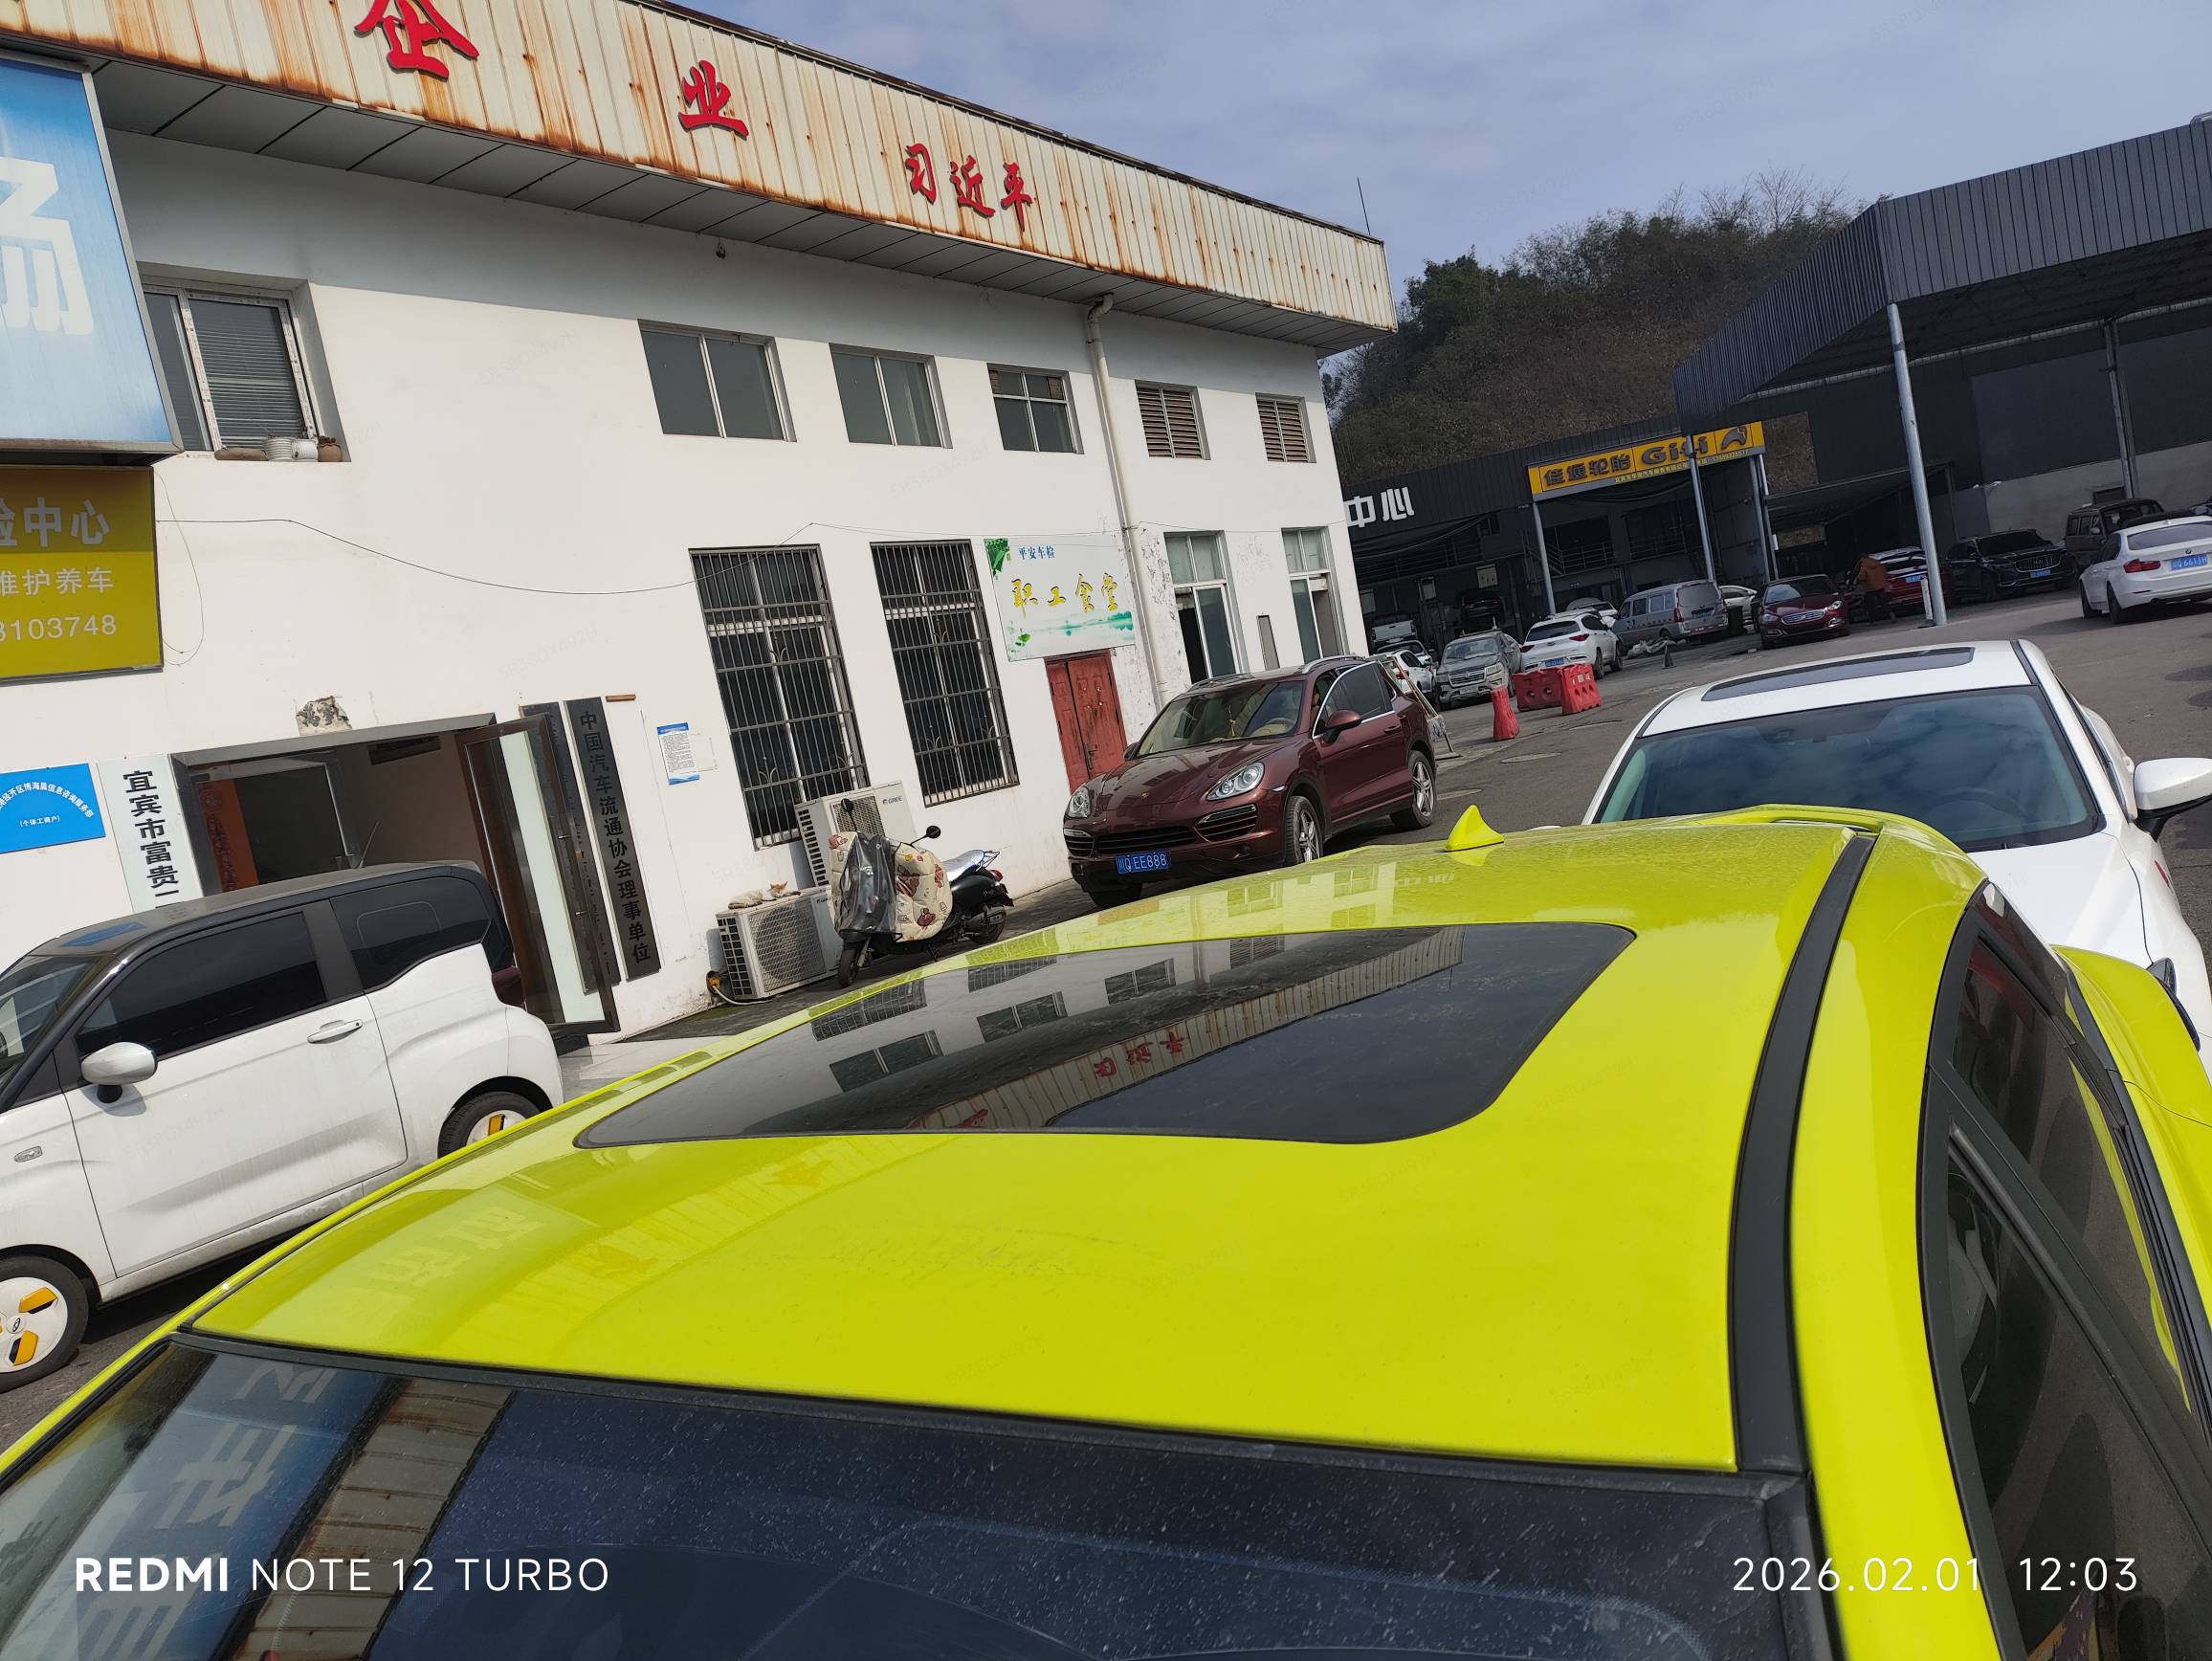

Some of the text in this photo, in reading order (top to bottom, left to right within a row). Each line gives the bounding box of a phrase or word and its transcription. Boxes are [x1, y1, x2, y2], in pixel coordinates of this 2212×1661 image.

[354, 0, 1032, 232] 企 业 习近平
[1543, 453, 1631, 486] 佳通轮胎
[1343, 486, 1415, 528] 中心
[1011, 572, 1118, 619] 职工食堂
[580, 711, 651, 963] 中国汽车流通协会理事单位
